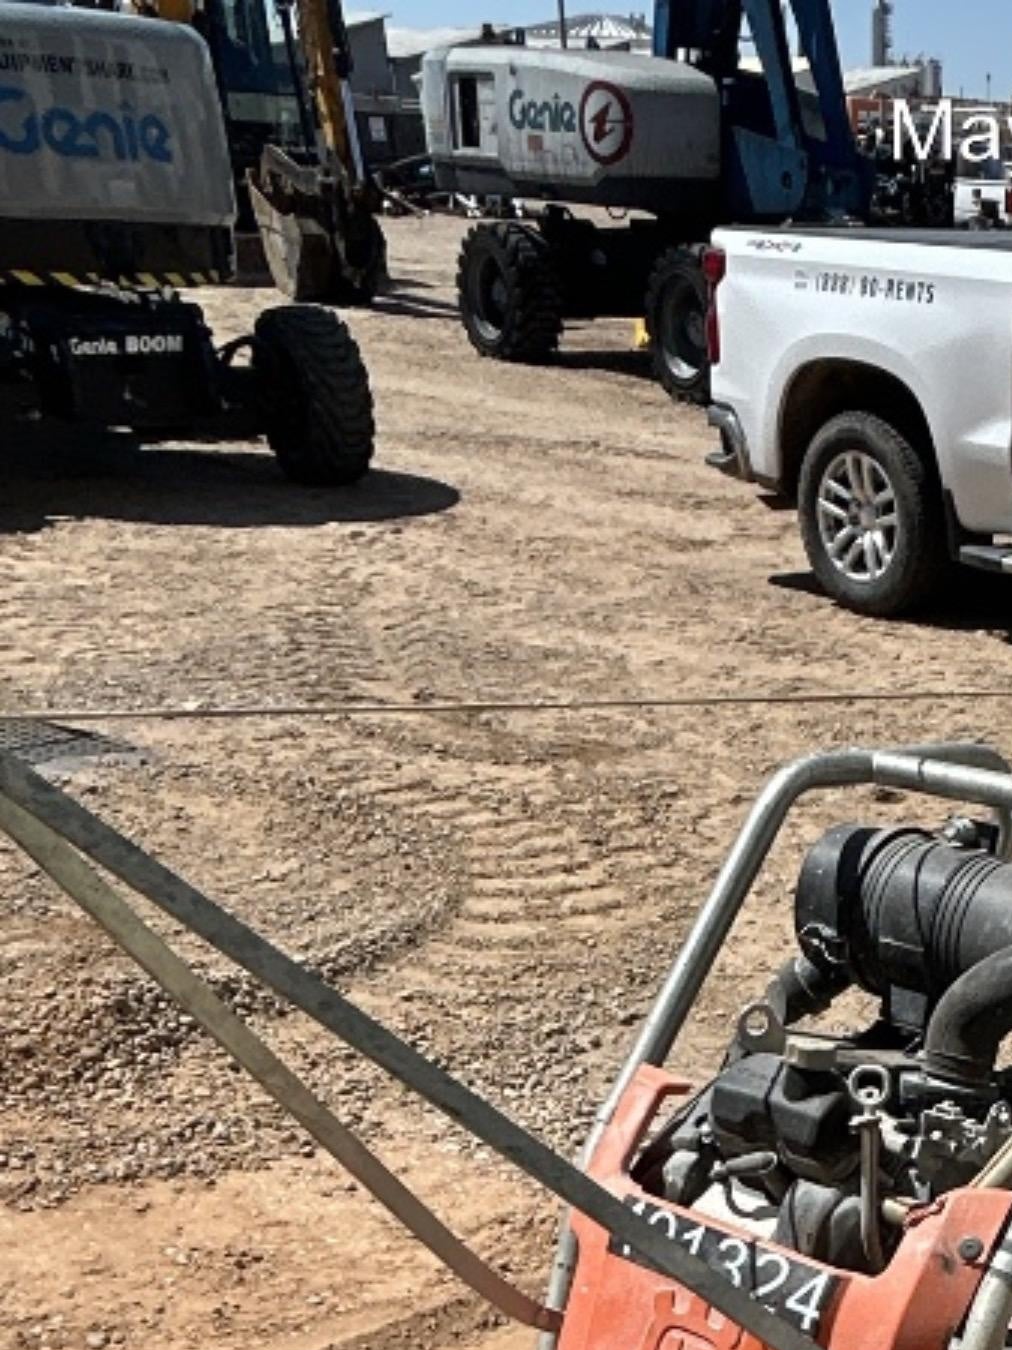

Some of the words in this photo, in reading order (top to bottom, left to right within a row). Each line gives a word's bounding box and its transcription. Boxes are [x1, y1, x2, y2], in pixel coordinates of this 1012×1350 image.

[0, 86, 173, 162] Genie
[509, 89, 576, 132] Genie
[125, 335, 183, 352] BOOM
[622, 1201, 829, 1330] 1324
